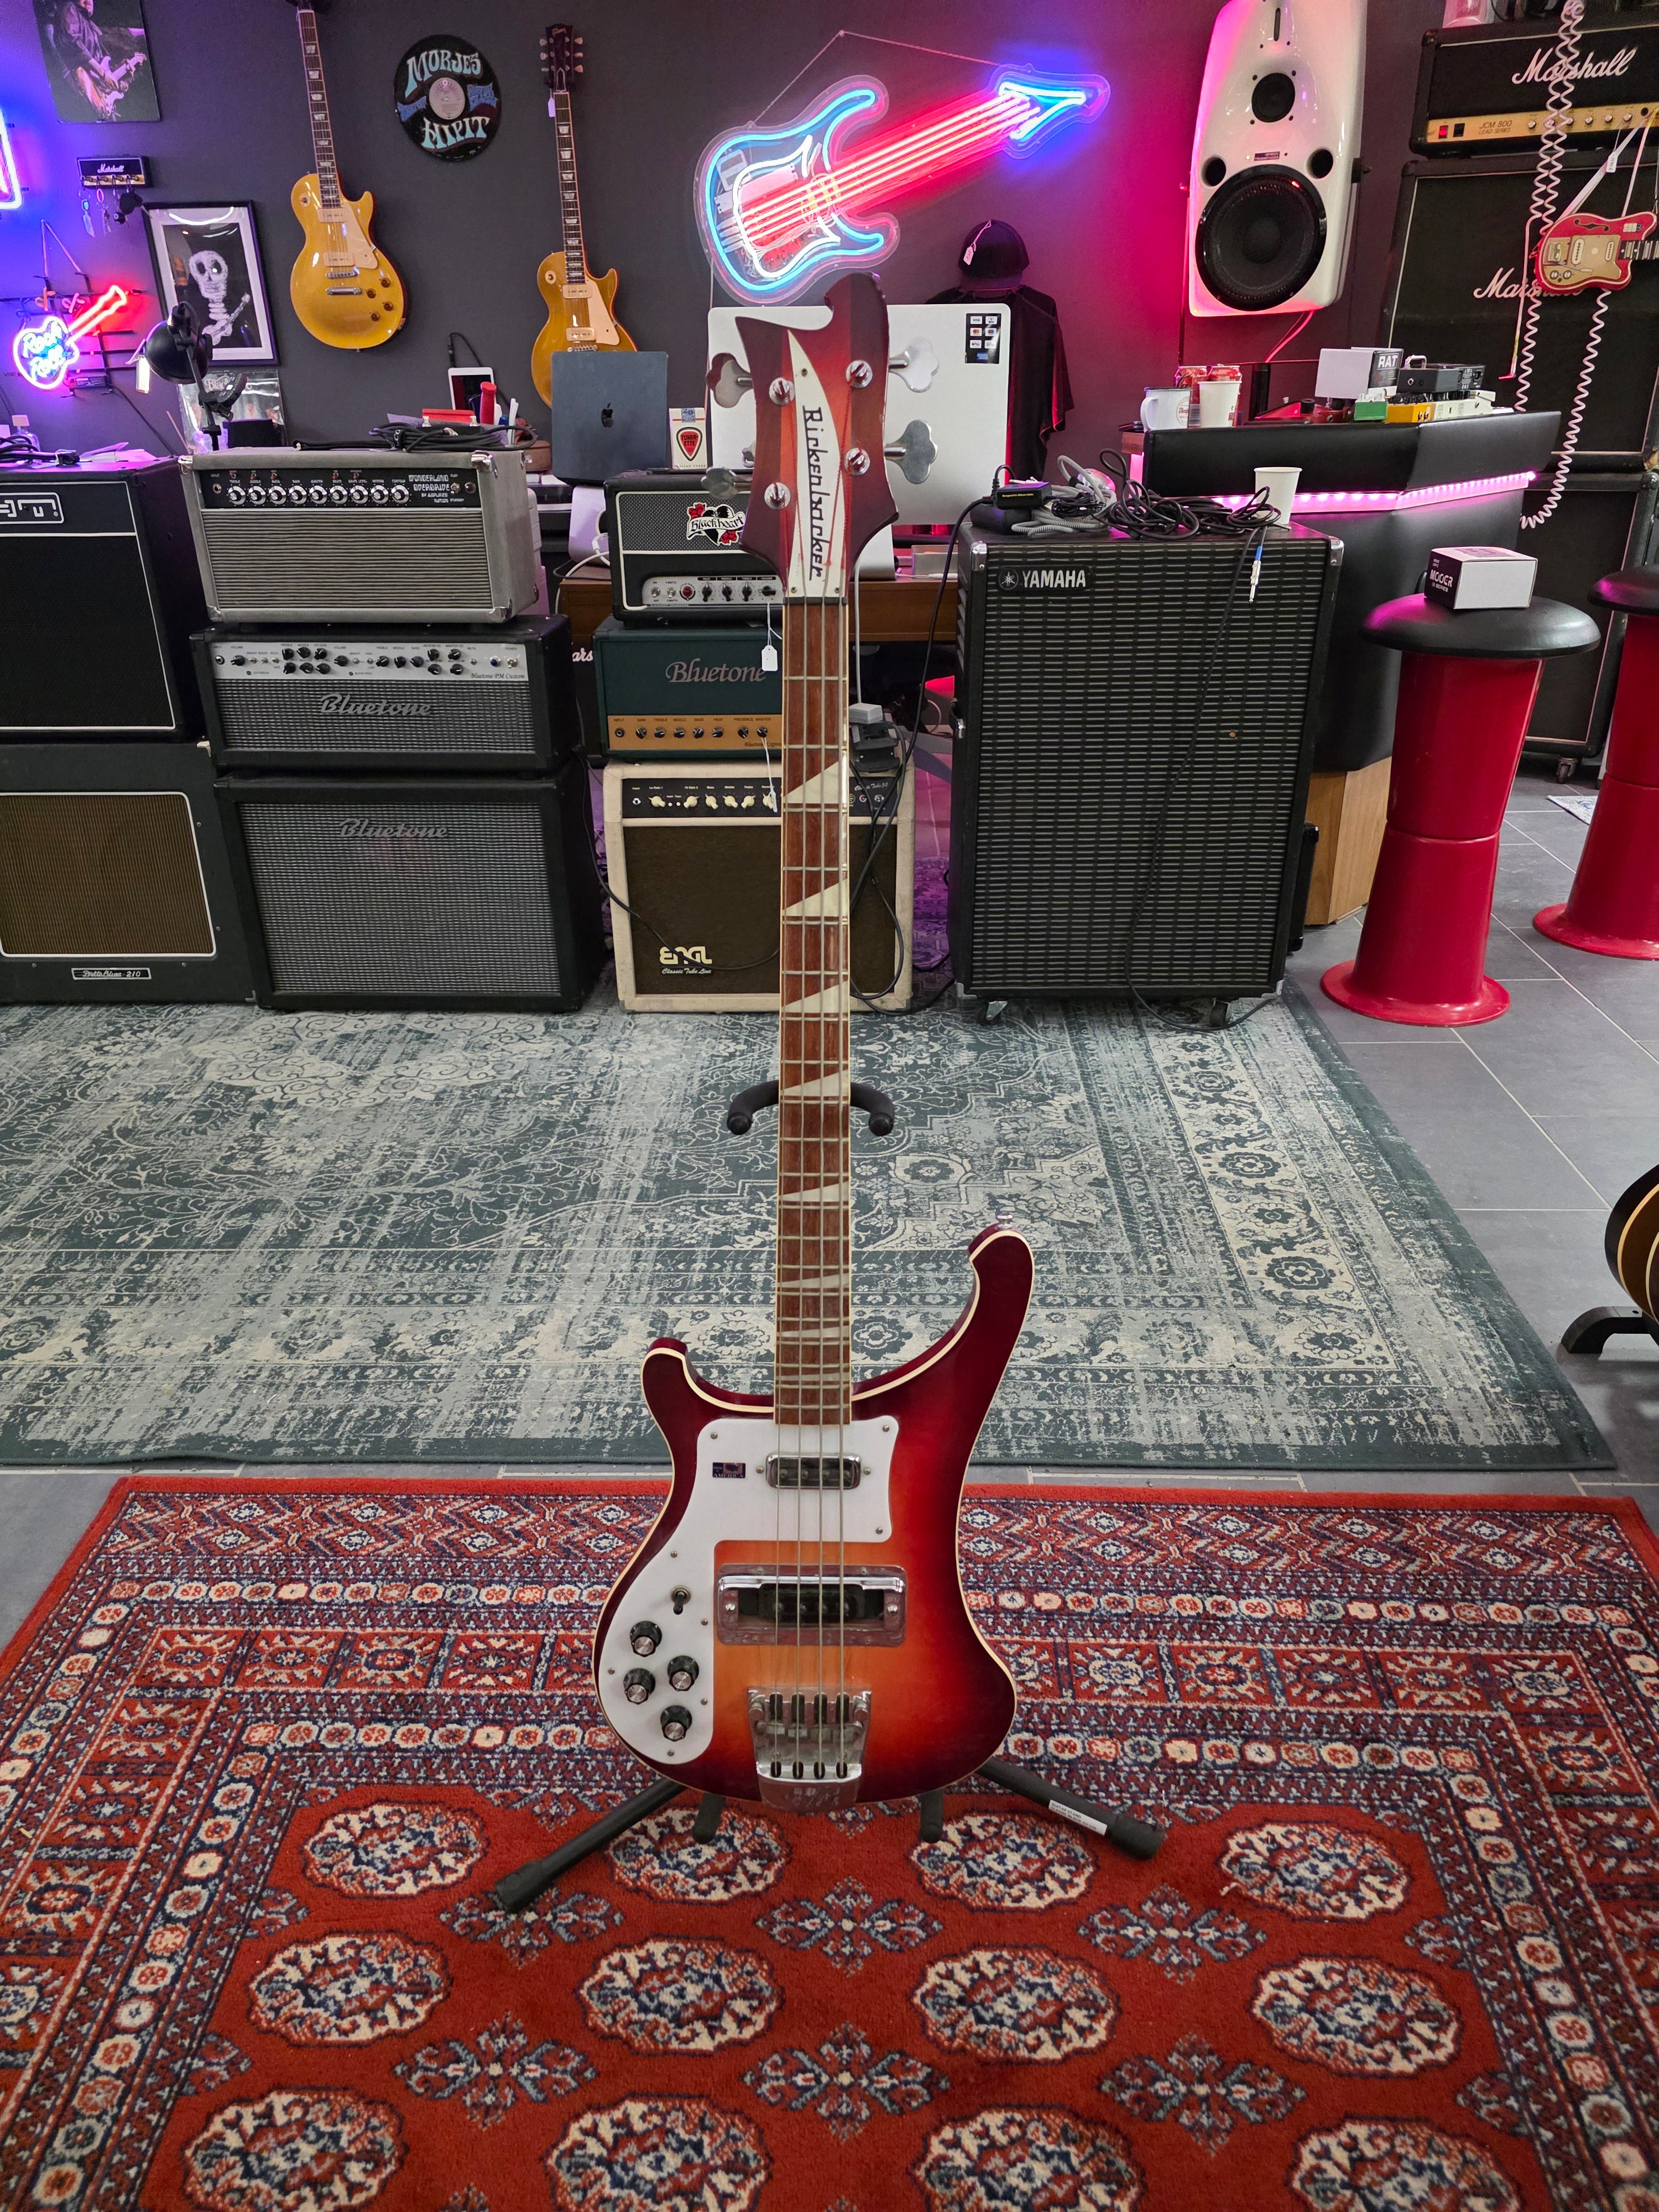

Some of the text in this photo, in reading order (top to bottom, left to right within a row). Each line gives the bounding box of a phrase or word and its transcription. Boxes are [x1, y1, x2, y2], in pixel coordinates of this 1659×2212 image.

[405, 50, 481, 98] MORJES
[421, 116, 490, 149] HIPIT
[1479, 121, 1495, 129] JCM
[97, 164, 124, 173] Marshall
[1378, 354, 1399, 368] RAT
[802, 405, 831, 581] Rickenbacker
[1022, 570, 1086, 588] YAMAHA
[665, 658, 767, 683] Bluetone
[320, 693, 431, 716] Bluetone
[338, 818, 448, 838] Bluetone
[1067, 1809, 1082, 1819] STAND
